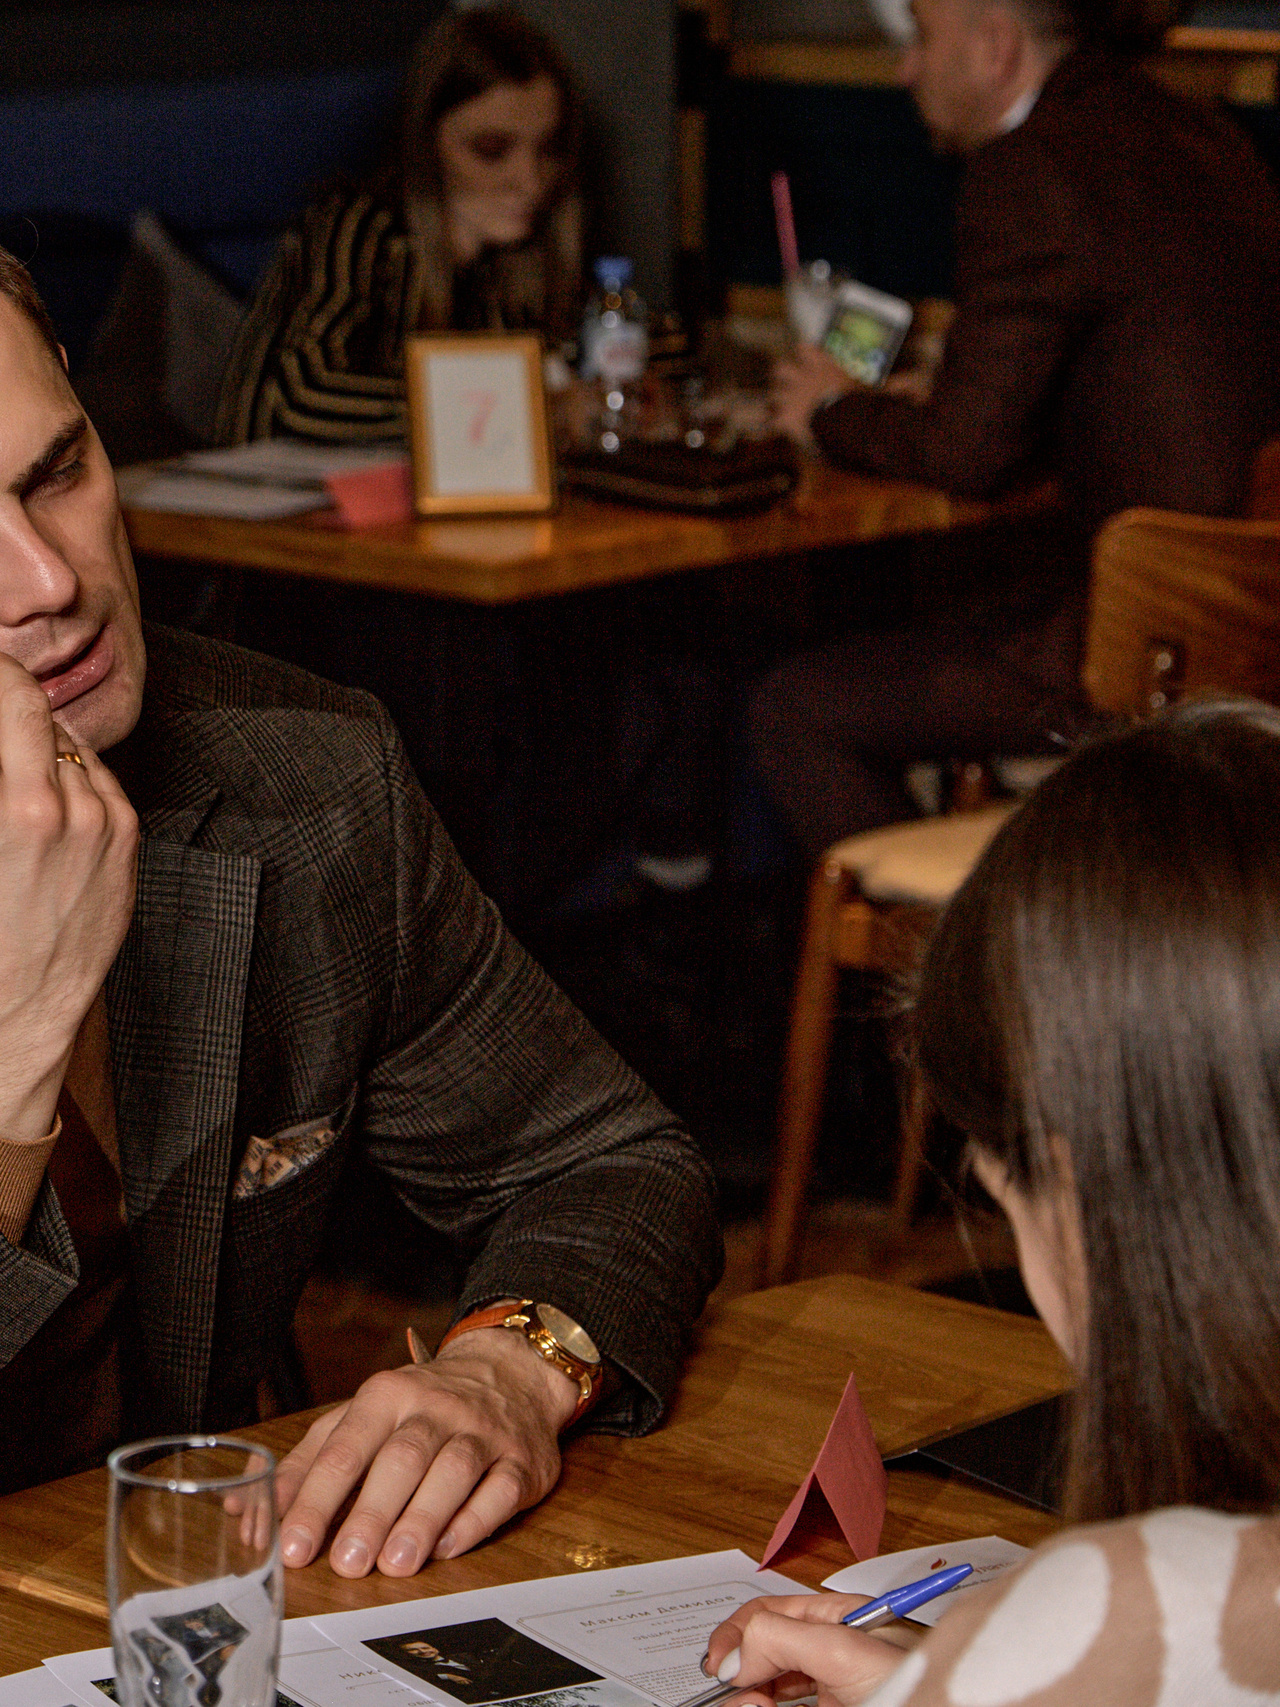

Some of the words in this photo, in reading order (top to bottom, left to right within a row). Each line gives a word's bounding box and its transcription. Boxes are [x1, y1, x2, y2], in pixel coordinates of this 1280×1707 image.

[460, 388, 497, 446] 7
[580, 1610, 651, 1628] Максим
[657, 1596, 735, 1614] Демидов
